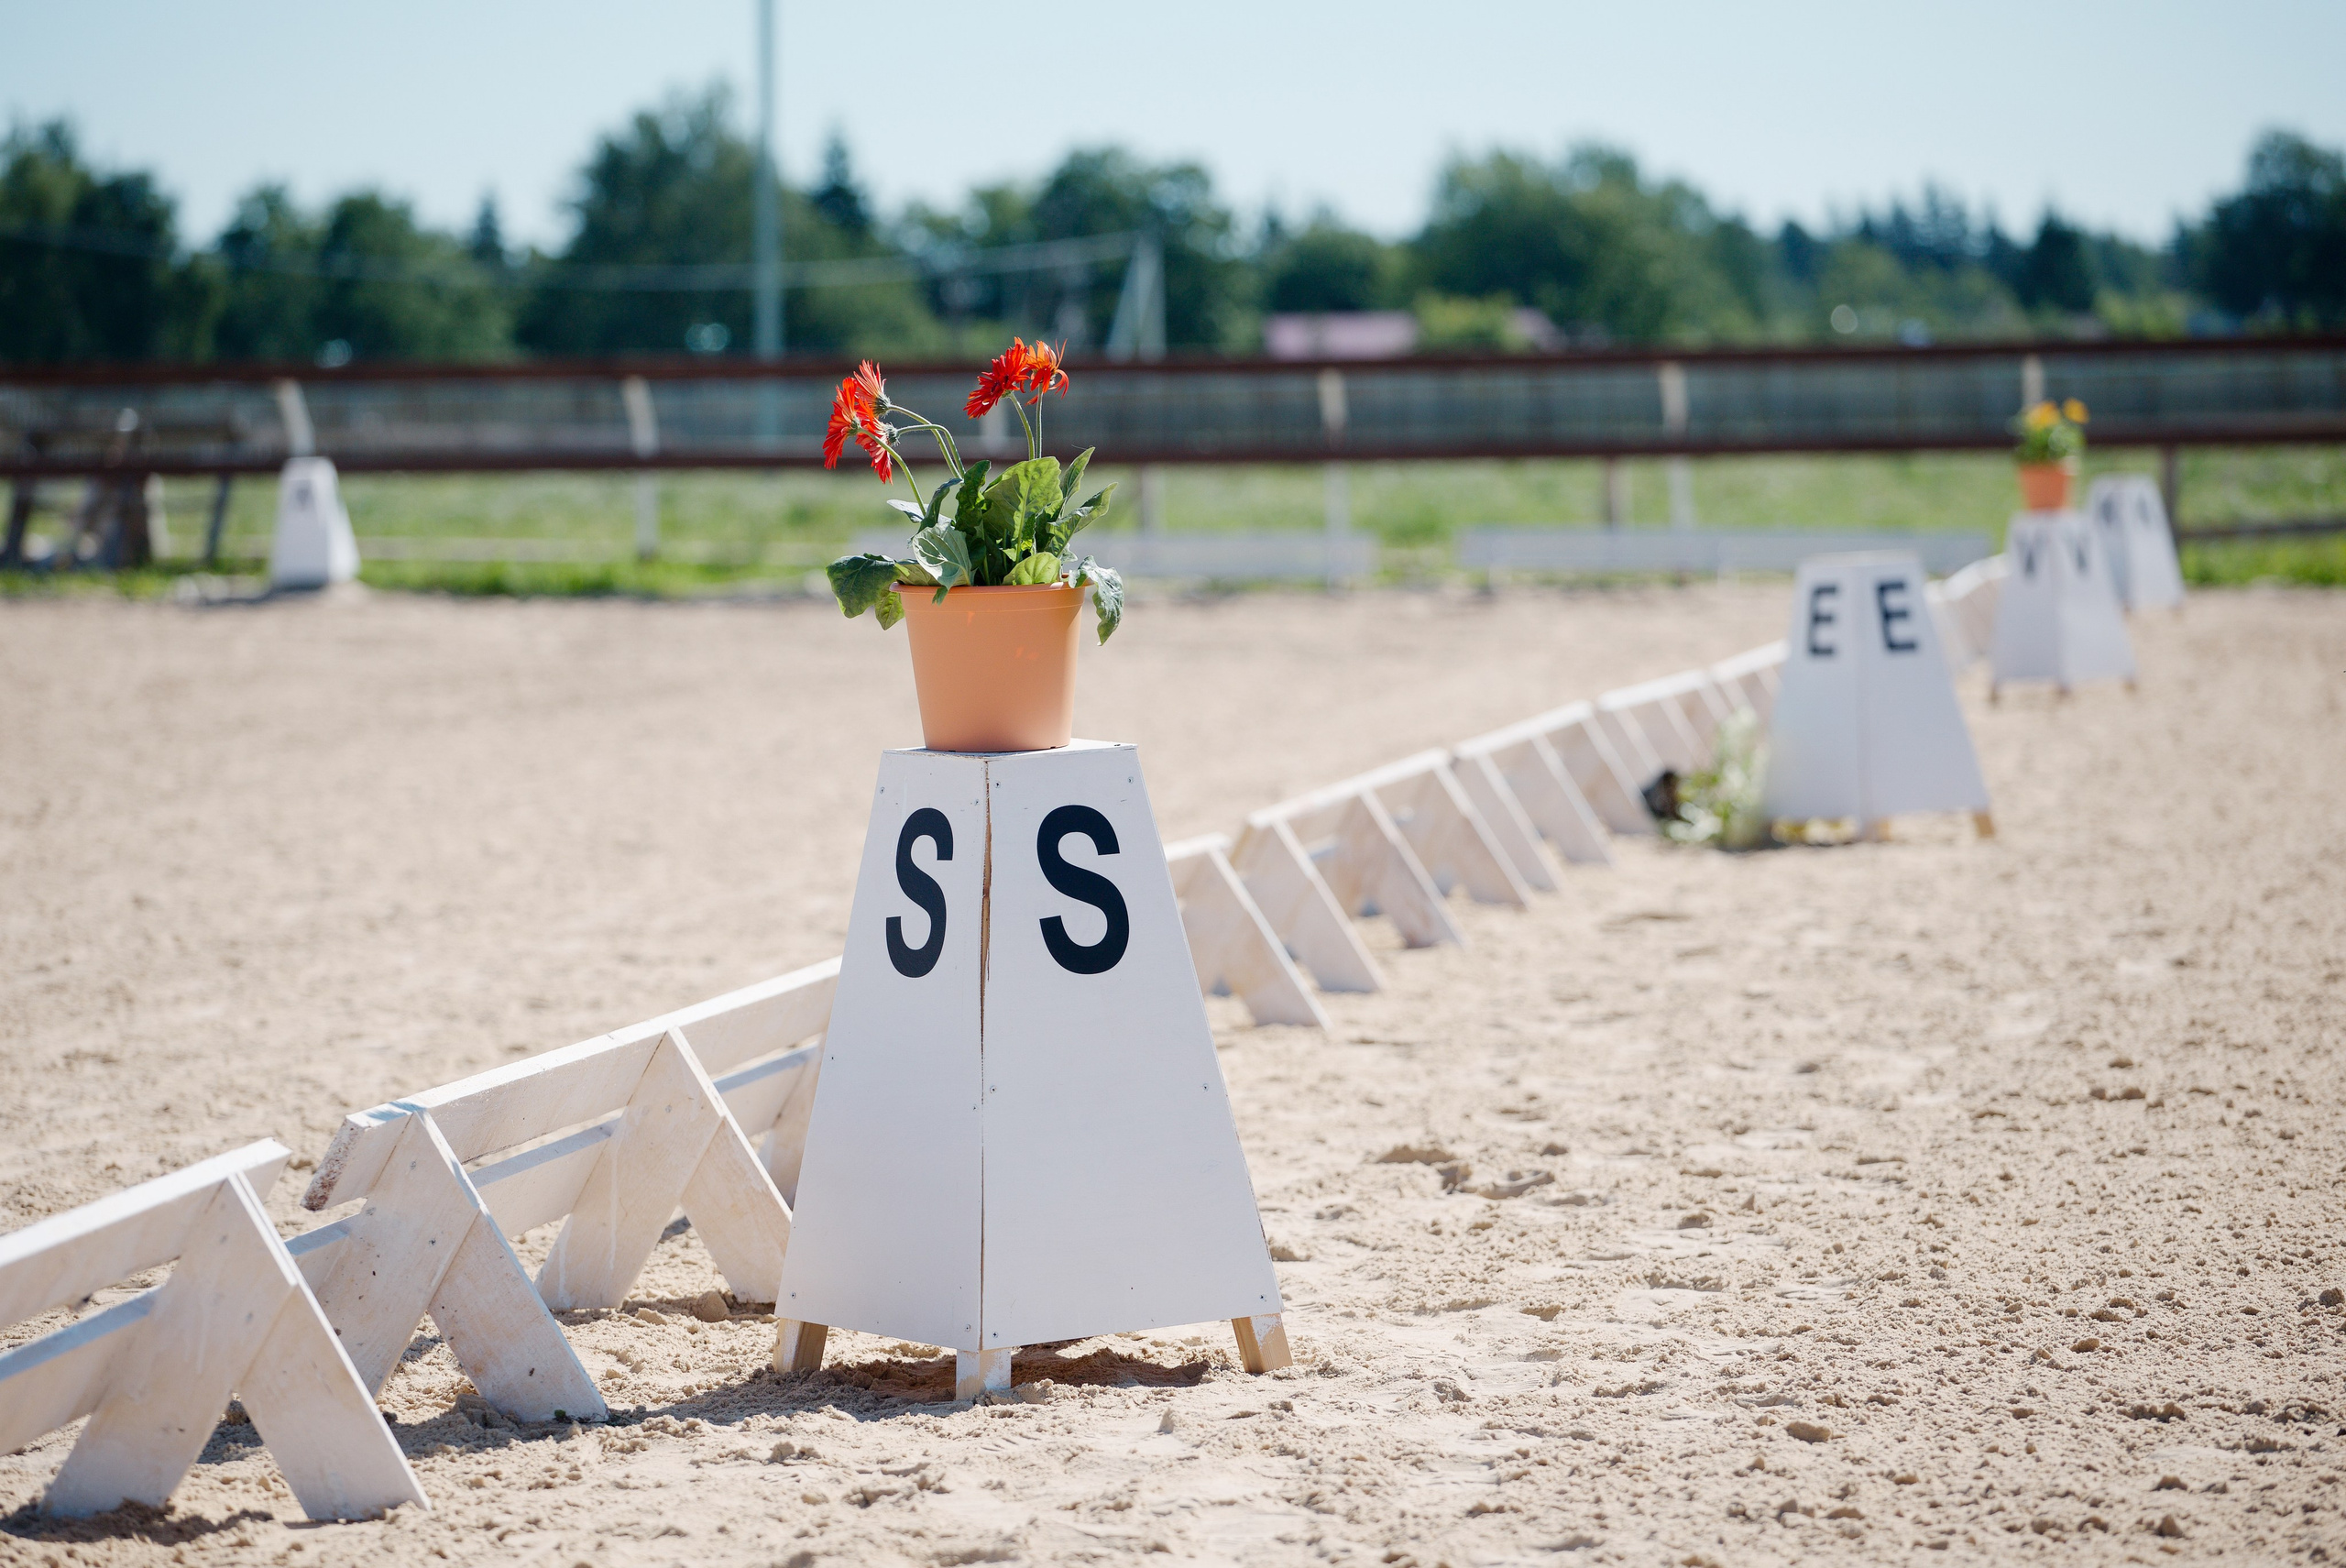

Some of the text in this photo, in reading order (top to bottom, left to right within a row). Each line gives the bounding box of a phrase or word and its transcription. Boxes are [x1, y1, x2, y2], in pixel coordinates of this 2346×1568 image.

[1807, 585, 1838, 658] E
[1875, 579, 1918, 653] E
[885, 806, 954, 979] S
[1036, 804, 1130, 975] S
